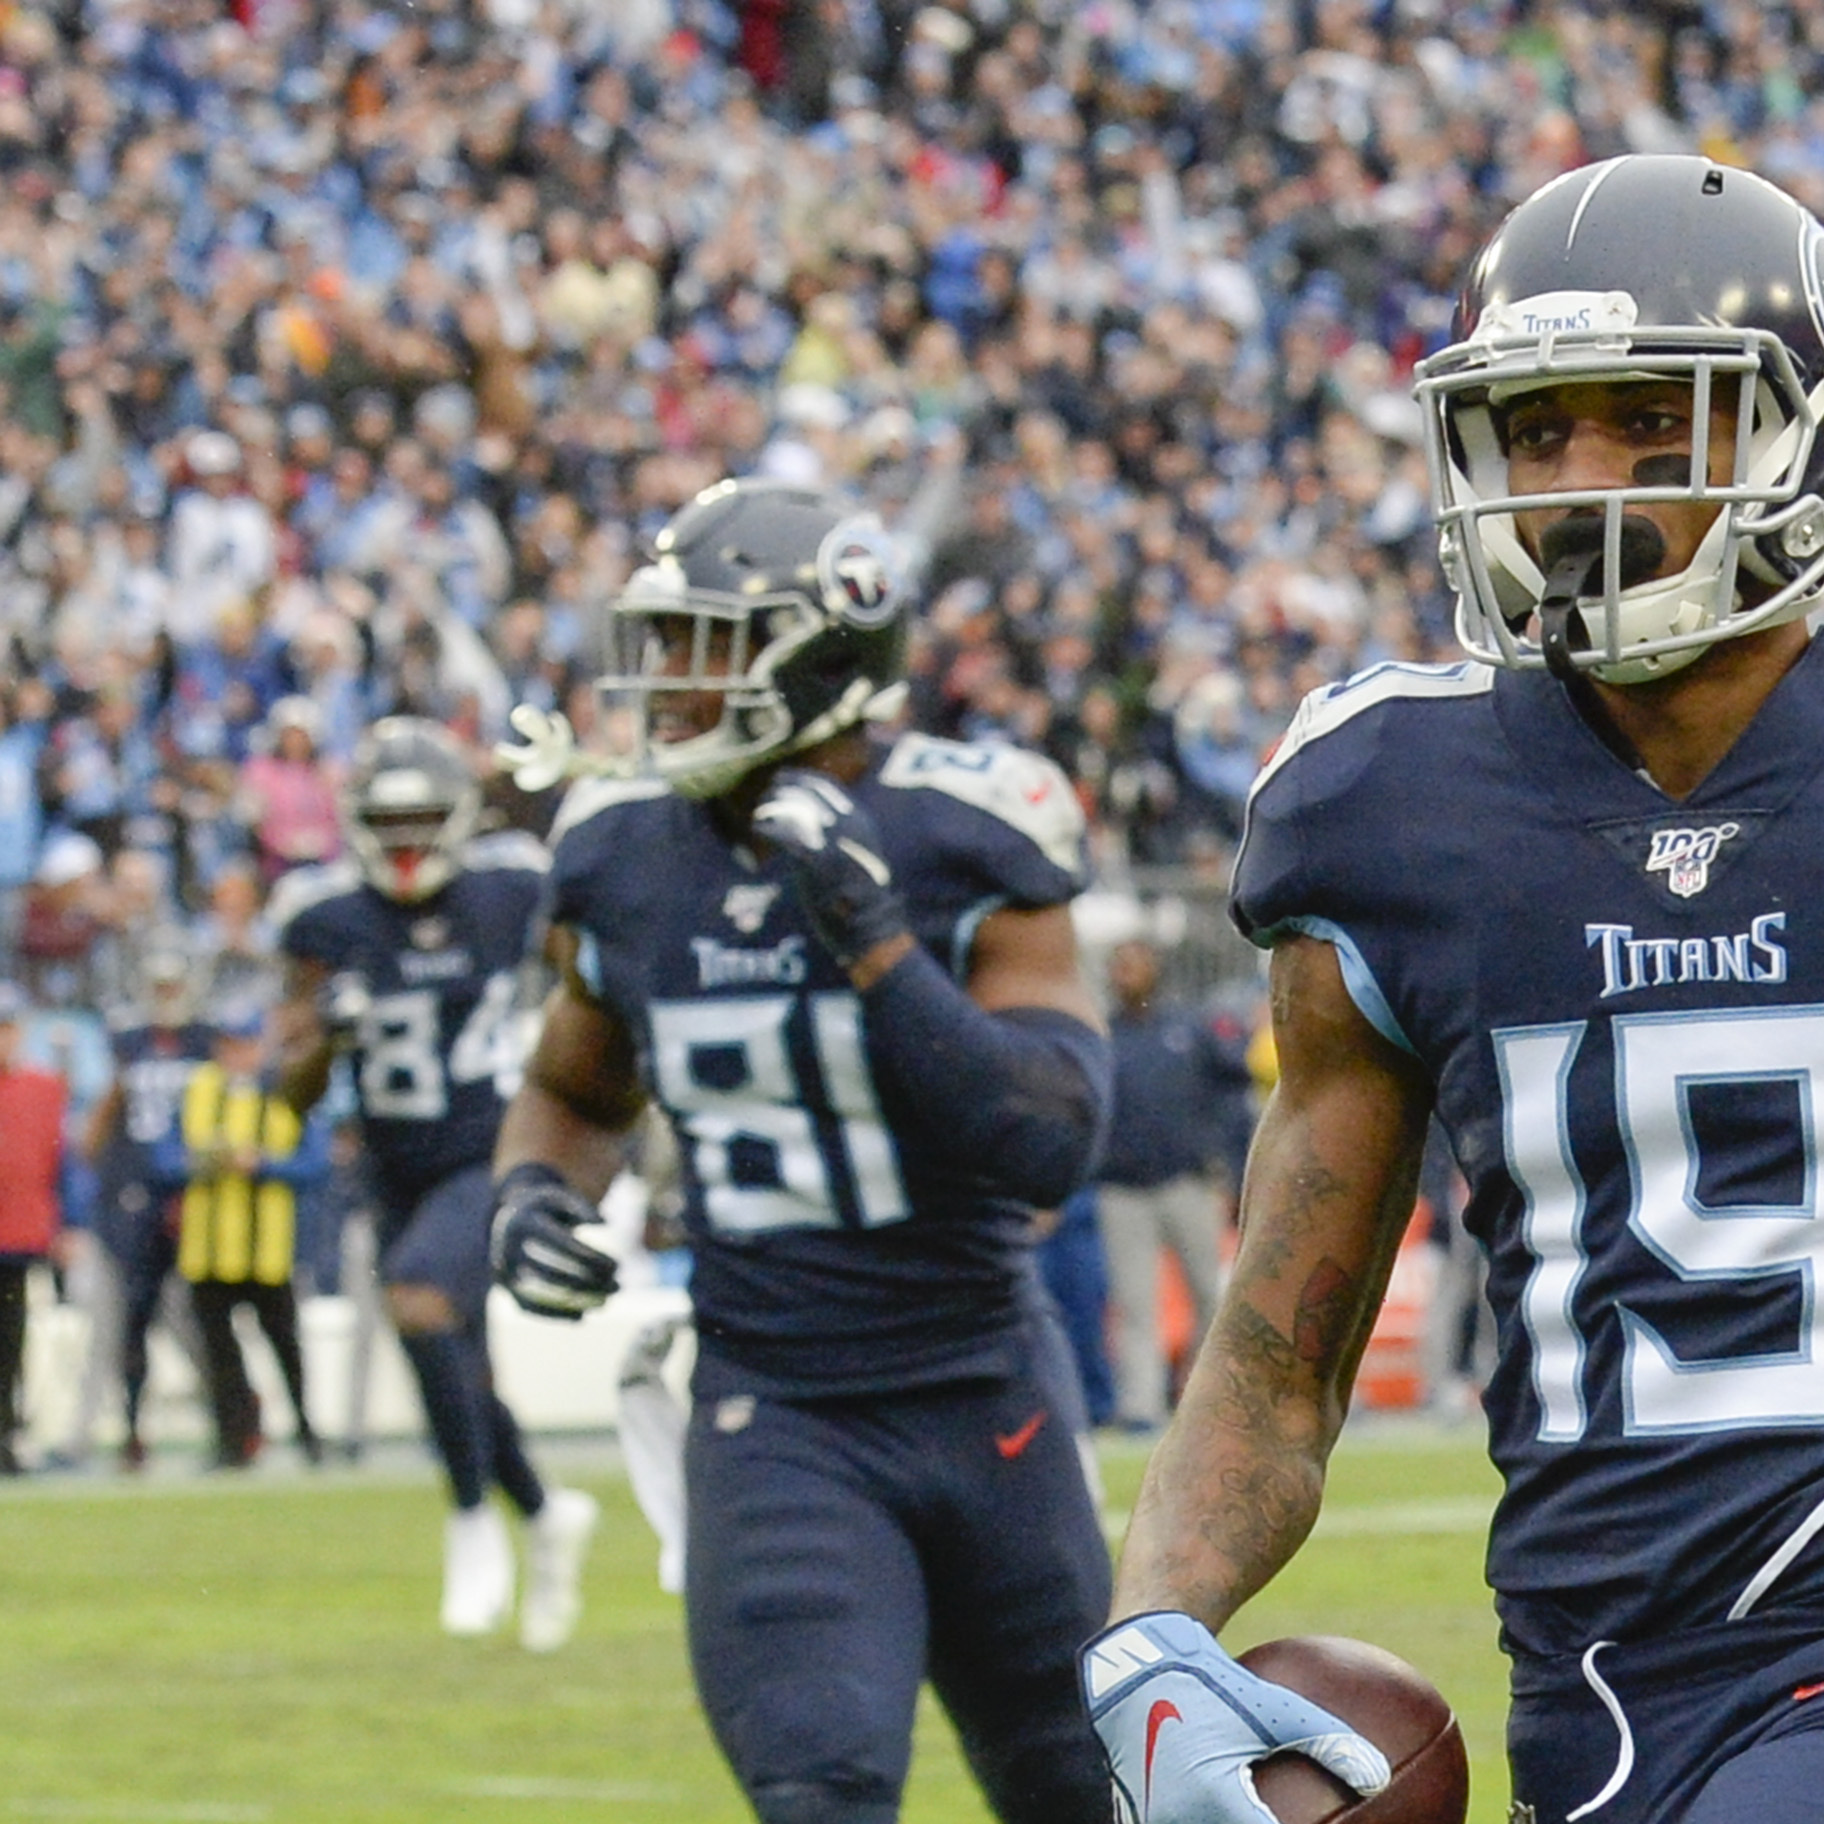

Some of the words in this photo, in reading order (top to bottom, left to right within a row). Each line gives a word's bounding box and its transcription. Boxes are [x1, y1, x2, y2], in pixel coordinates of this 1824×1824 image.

[1523, 308, 1591, 333] TITANS
[1585, 912, 1787, 999] TITANS
[356, 970, 544, 1120] 84
[646, 988, 913, 1234] 81
